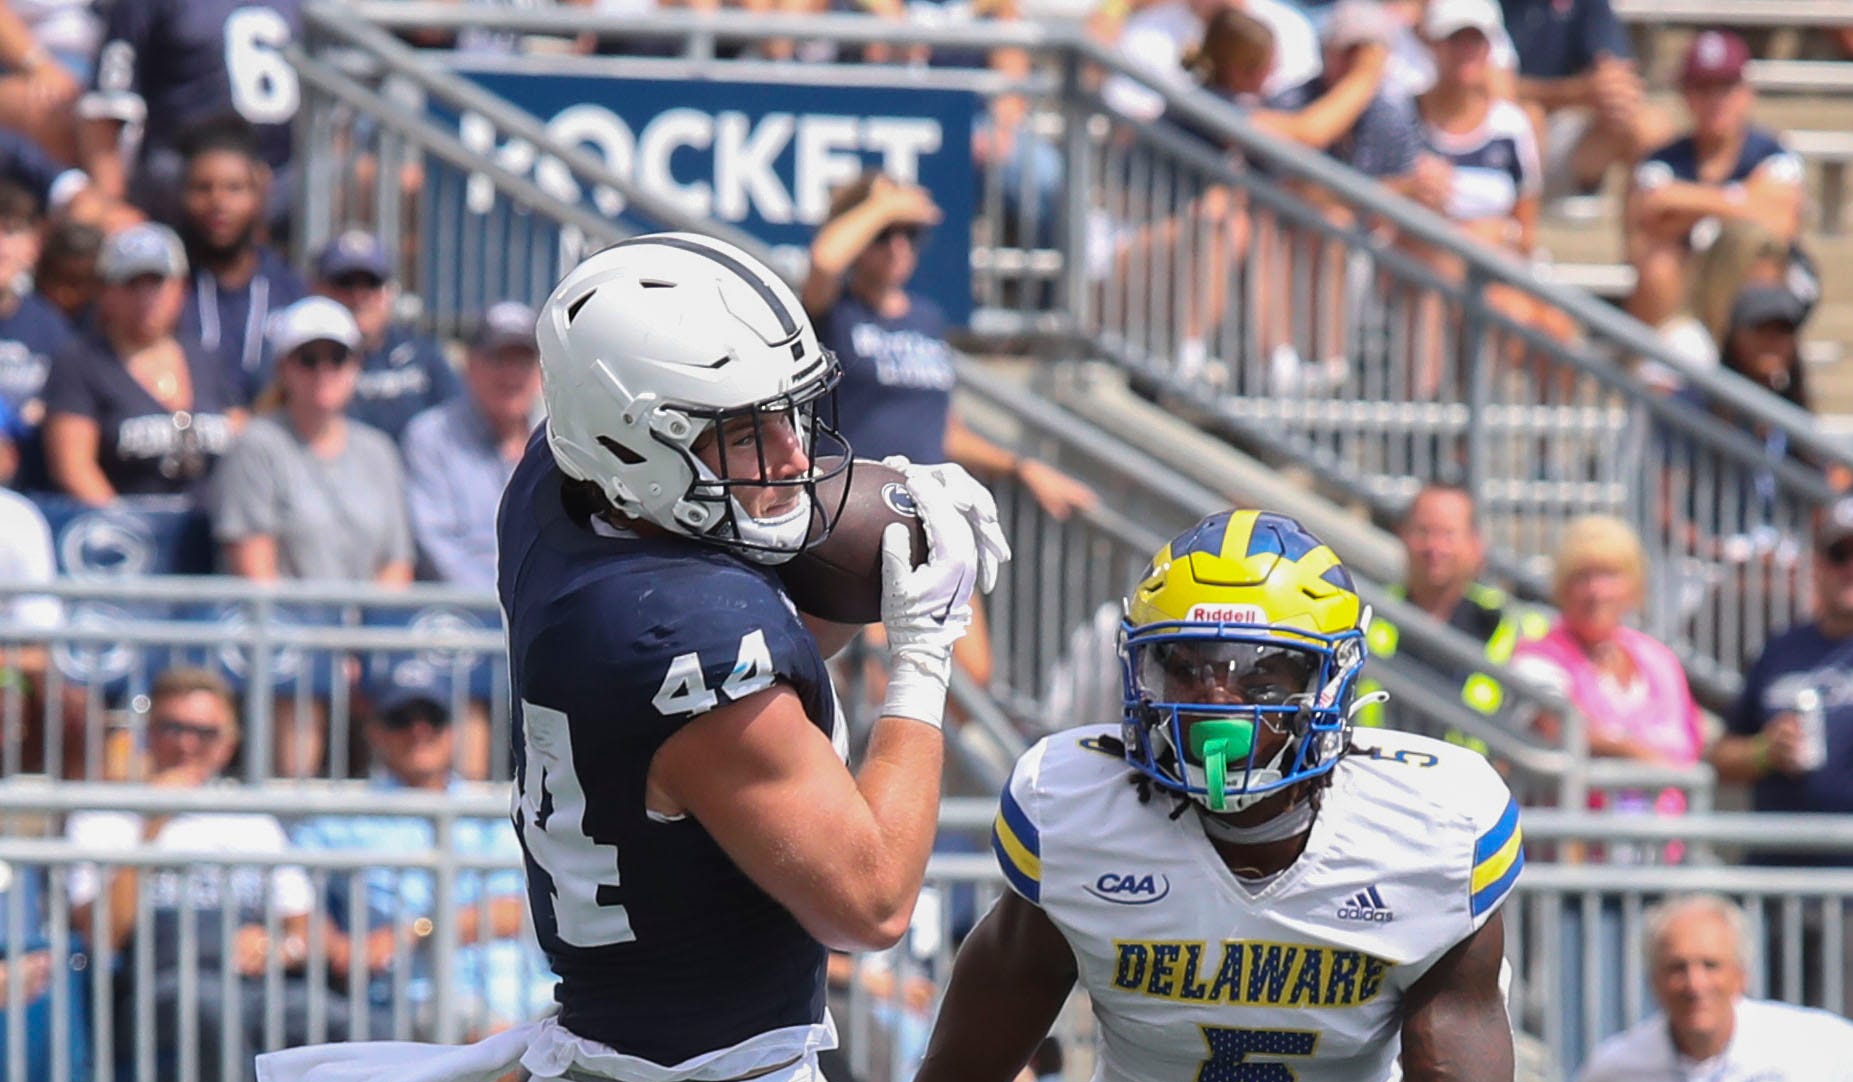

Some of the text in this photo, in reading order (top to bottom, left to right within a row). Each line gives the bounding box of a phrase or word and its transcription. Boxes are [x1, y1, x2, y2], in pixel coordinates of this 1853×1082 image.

[223, 6, 300, 124] 6
[1193, 607, 1257, 623] Riddell
[651, 628, 778, 720] 44
[1095, 872, 1157, 896] CAA
[1336, 904, 1395, 924] adidas
[1111, 938, 1398, 1009] DELAWARE
